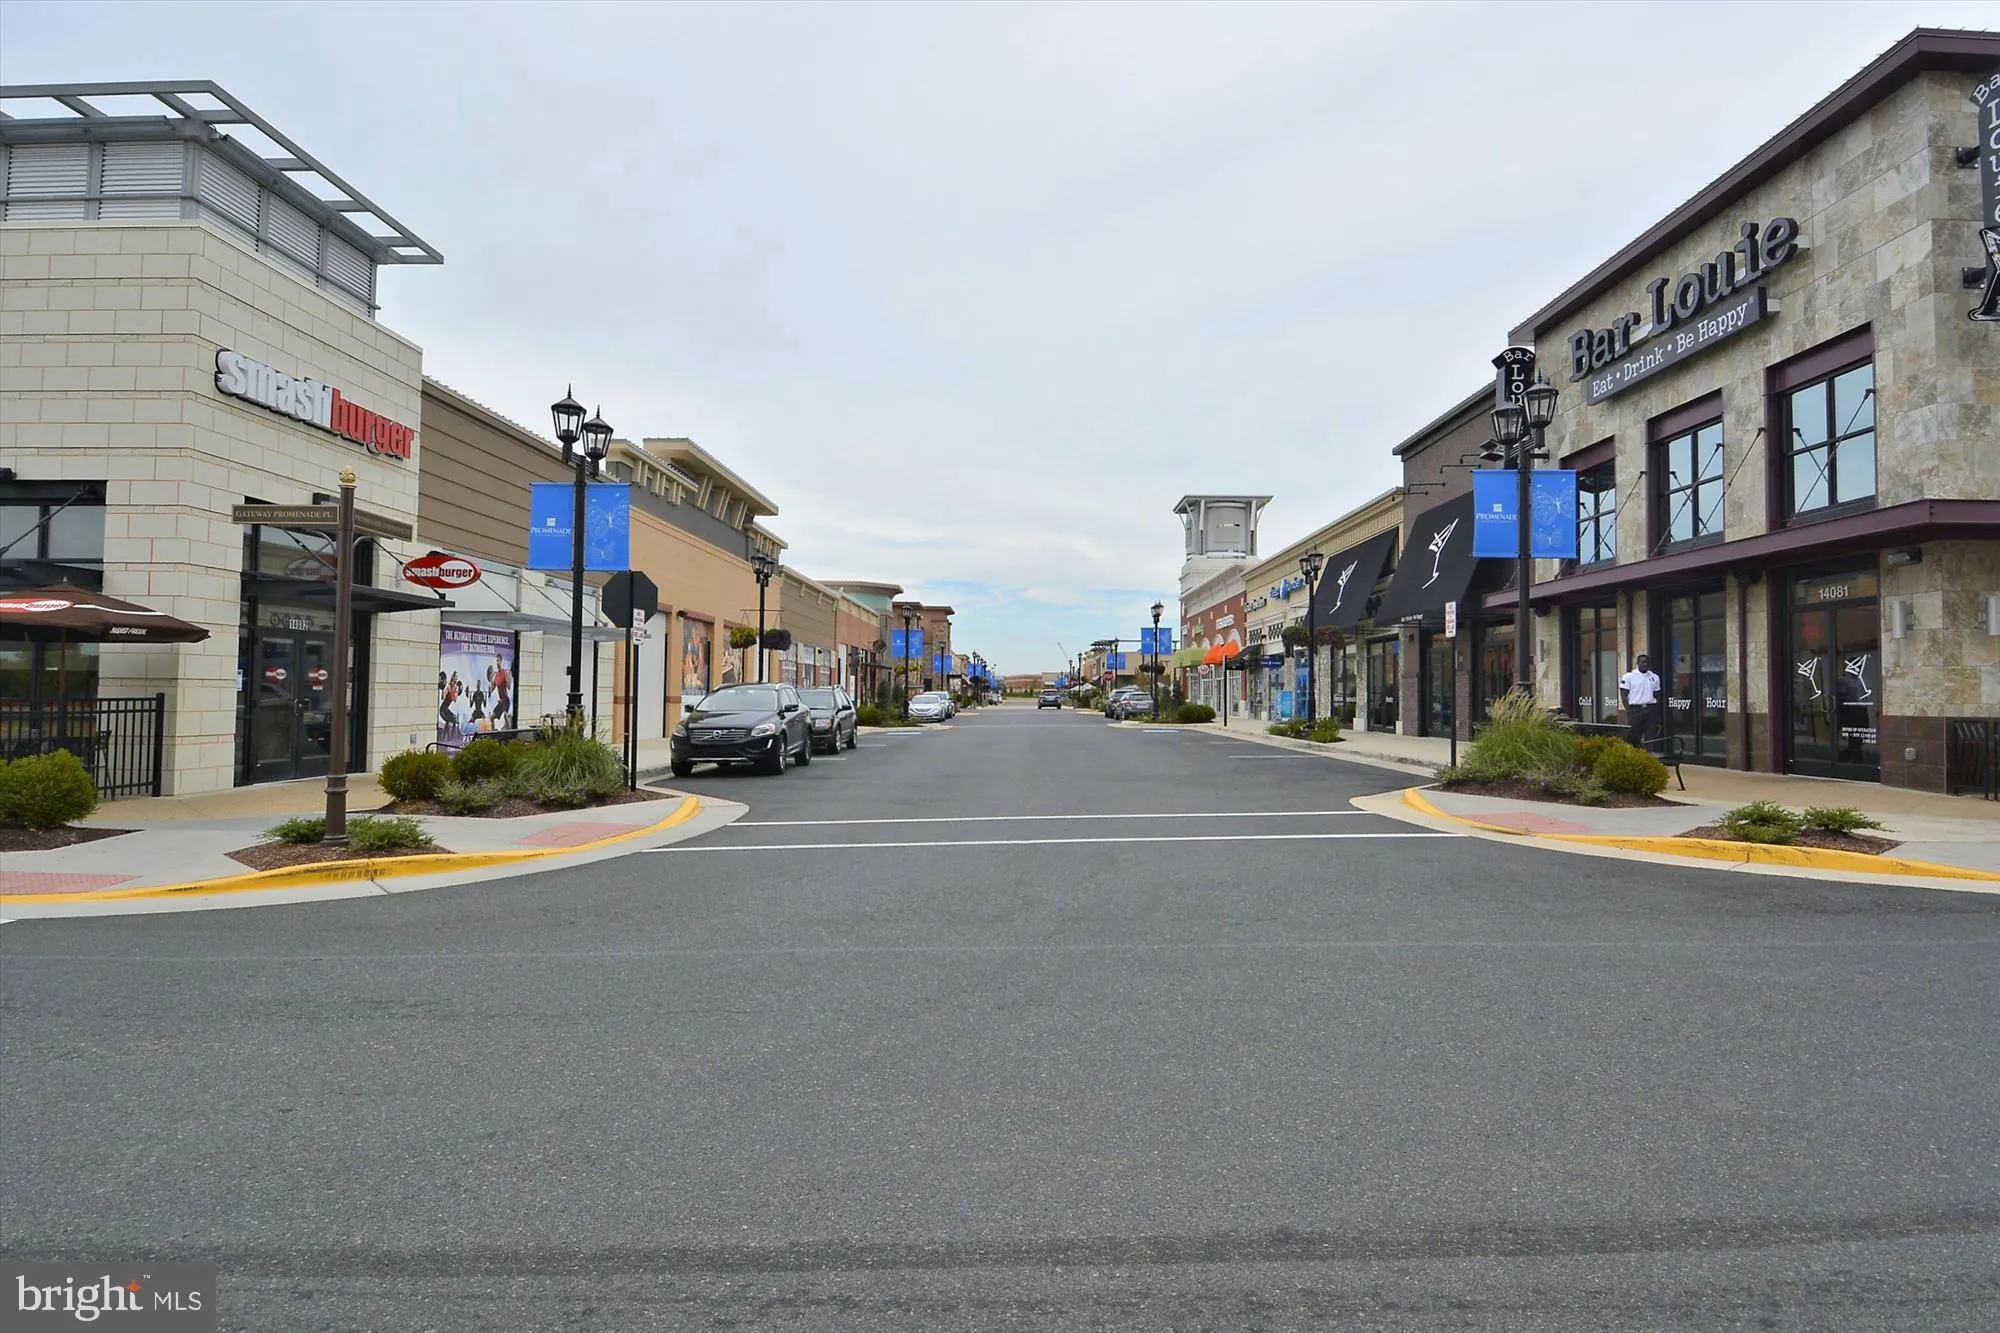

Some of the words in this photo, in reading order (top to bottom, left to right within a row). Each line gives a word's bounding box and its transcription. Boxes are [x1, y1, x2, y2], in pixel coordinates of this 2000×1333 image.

[1568, 311, 1641, 383] Bar
[1647, 217, 1799, 338] Louie
[1502, 350, 1535, 363] Bar
[1591, 373, 1614, 399] Eat
[1623, 346, 1665, 381] Drink
[1675, 331, 1696, 354] Be
[1696, 302, 1750, 343] Happy
[1510, 364, 1525, 406] Lou
[215, 349, 415, 459] smashburger
[235, 510, 272, 519] GATEWAY
[273, 510, 321, 519] PROMENADE
[1818, 585, 1849, 600] 14081
[445, 630, 454, 640] THE
[1578, 696, 1593, 706] Cold
[1668, 697, 1692, 710] Happy
[1706, 696, 1727, 709] Hour
